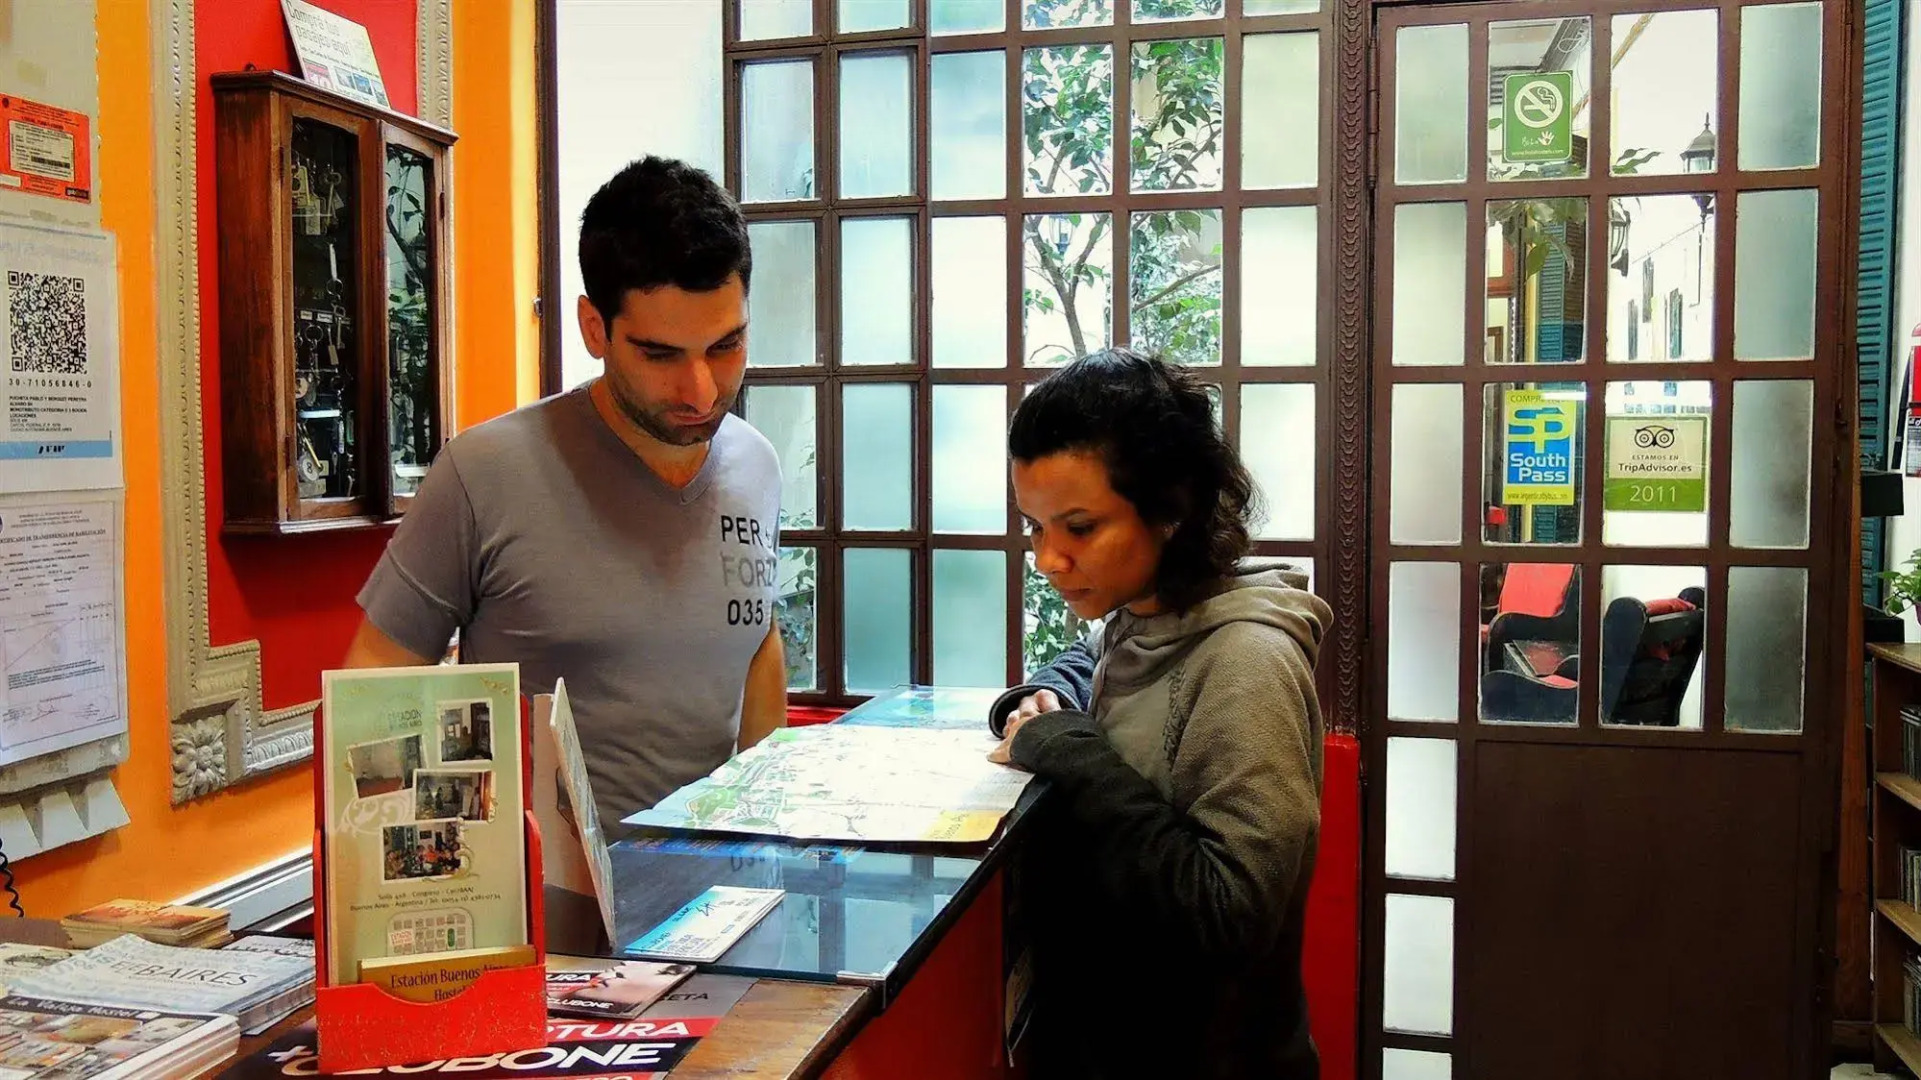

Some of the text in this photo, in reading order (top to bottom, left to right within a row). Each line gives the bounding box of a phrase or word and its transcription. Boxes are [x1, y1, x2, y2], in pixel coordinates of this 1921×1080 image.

[1510, 453, 1566, 468] South
[1618, 462, 1692, 474] TripAdvisor.es
[1518, 469, 1566, 482] Pass
[1629, 484, 1677, 503] 2011
[727, 599, 764, 625] 035
[395, 900, 424, 909] Argentina
[440, 967, 481, 983] Buenos
[434, 983, 470, 1001] Host
